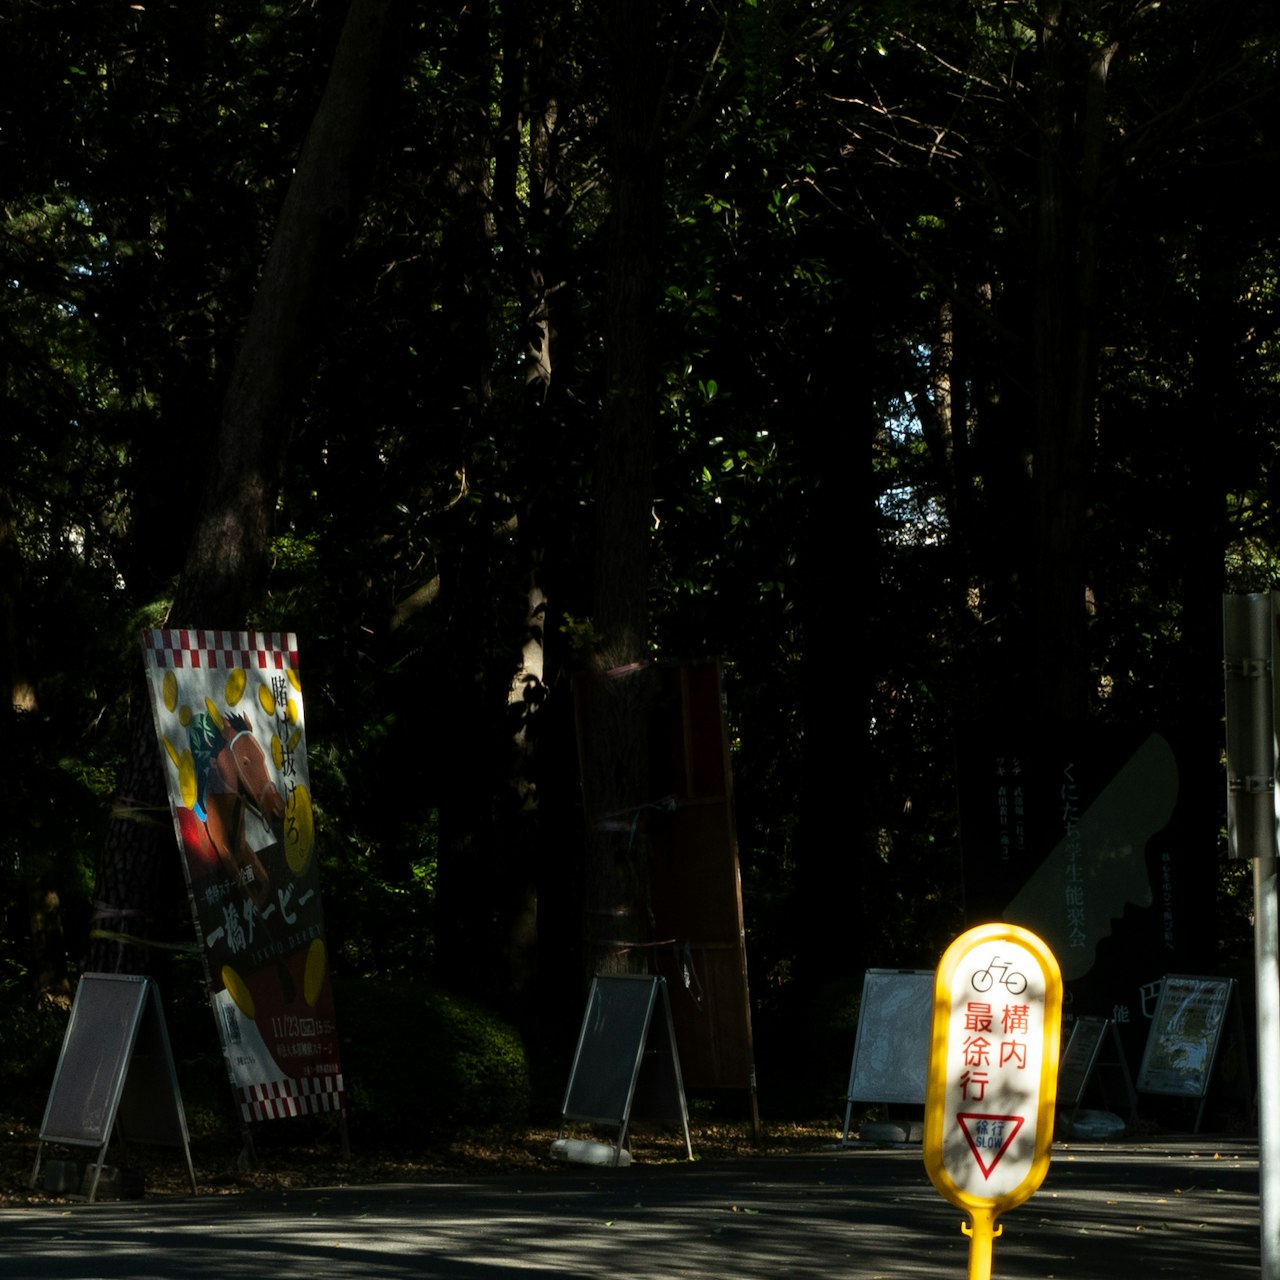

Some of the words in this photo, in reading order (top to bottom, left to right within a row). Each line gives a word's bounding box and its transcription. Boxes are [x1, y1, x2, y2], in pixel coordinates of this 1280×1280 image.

[271, 675, 305, 859] 賭け抜けろ。
[1061, 762, 1086, 949] くにたち学生能楽会
[206, 881, 315, 955] 一橋ダービー
[272, 1015, 300, 1038] 11/23
[959, 1002, 994, 1102] 最徐行
[1000, 1004, 1030, 1069] 構内
[975, 1120, 1004, 1136] 徐行
[975, 1134, 1003, 1149] SLOW
